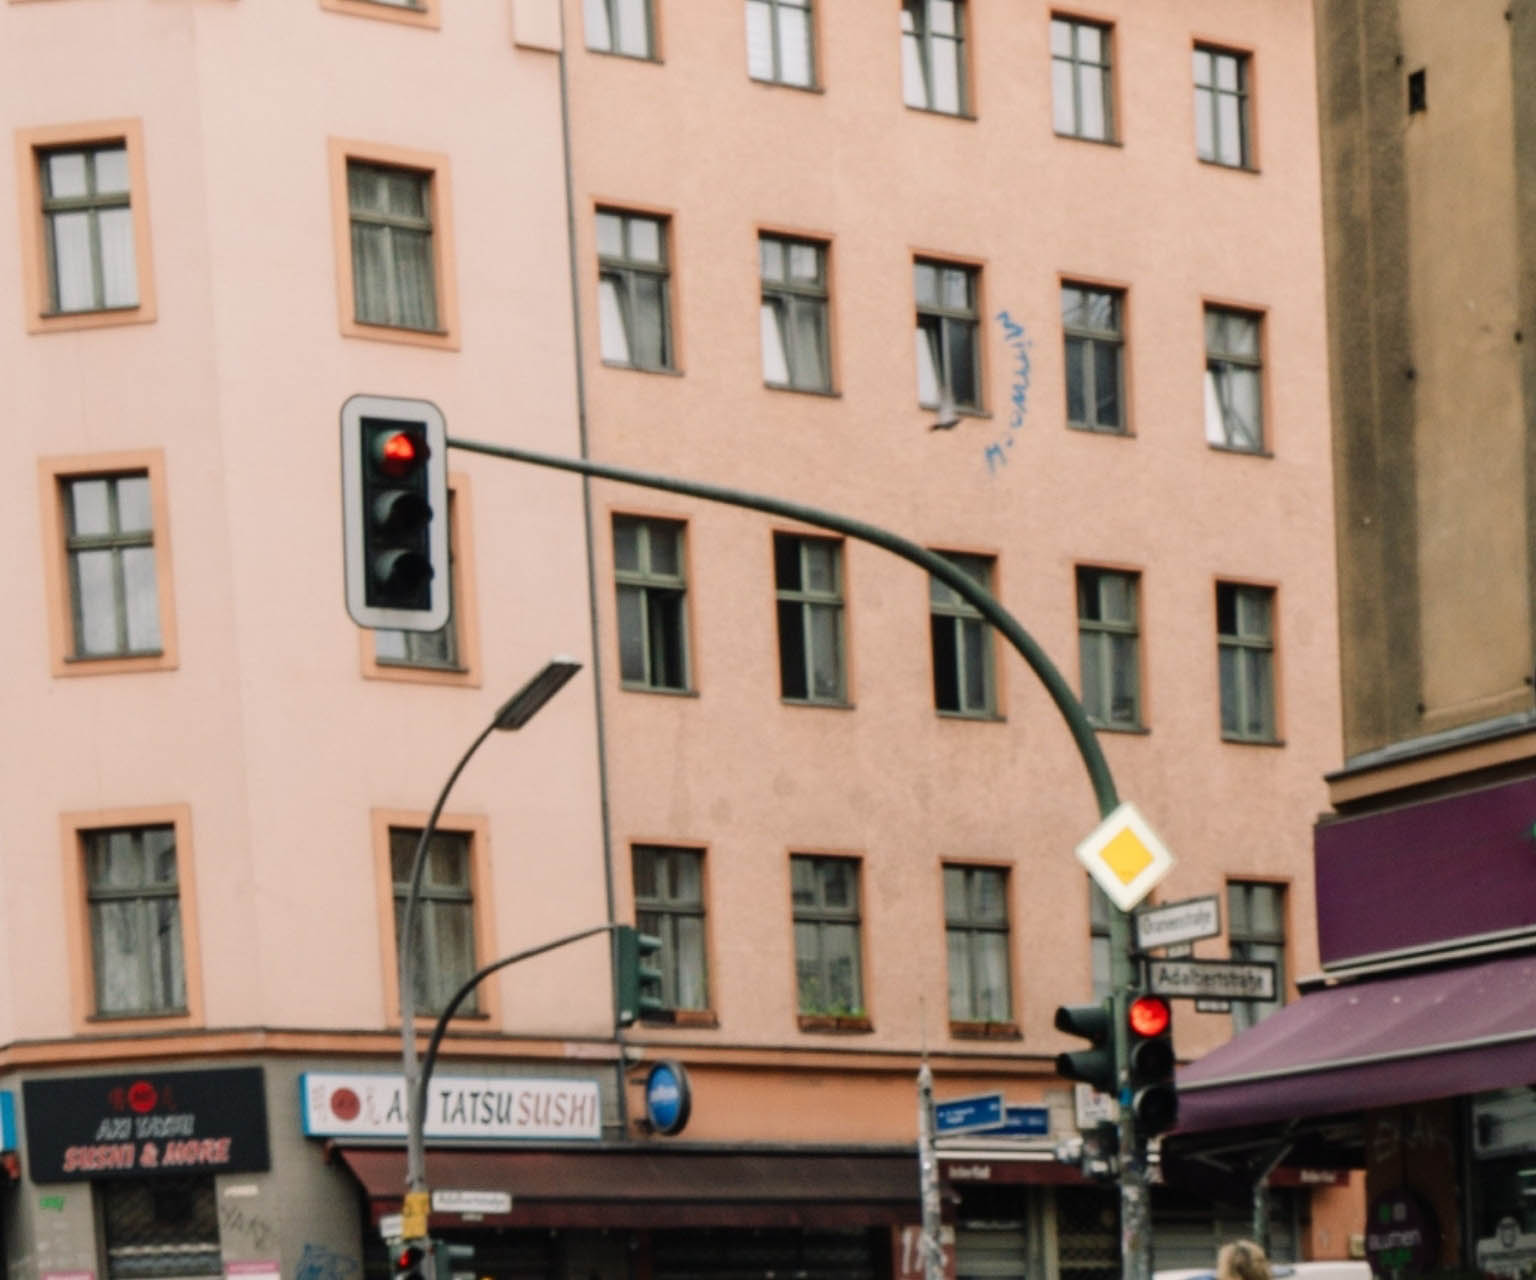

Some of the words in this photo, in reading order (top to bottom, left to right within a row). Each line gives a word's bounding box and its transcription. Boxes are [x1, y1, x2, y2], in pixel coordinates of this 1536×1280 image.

[440, 1090, 513, 1126] TATSU
[516, 1090, 597, 1127] SUSHI
[63, 1142, 135, 1172] SUSHI
[139, 1141, 159, 1168] &
[161, 1136, 232, 1167] MORE
